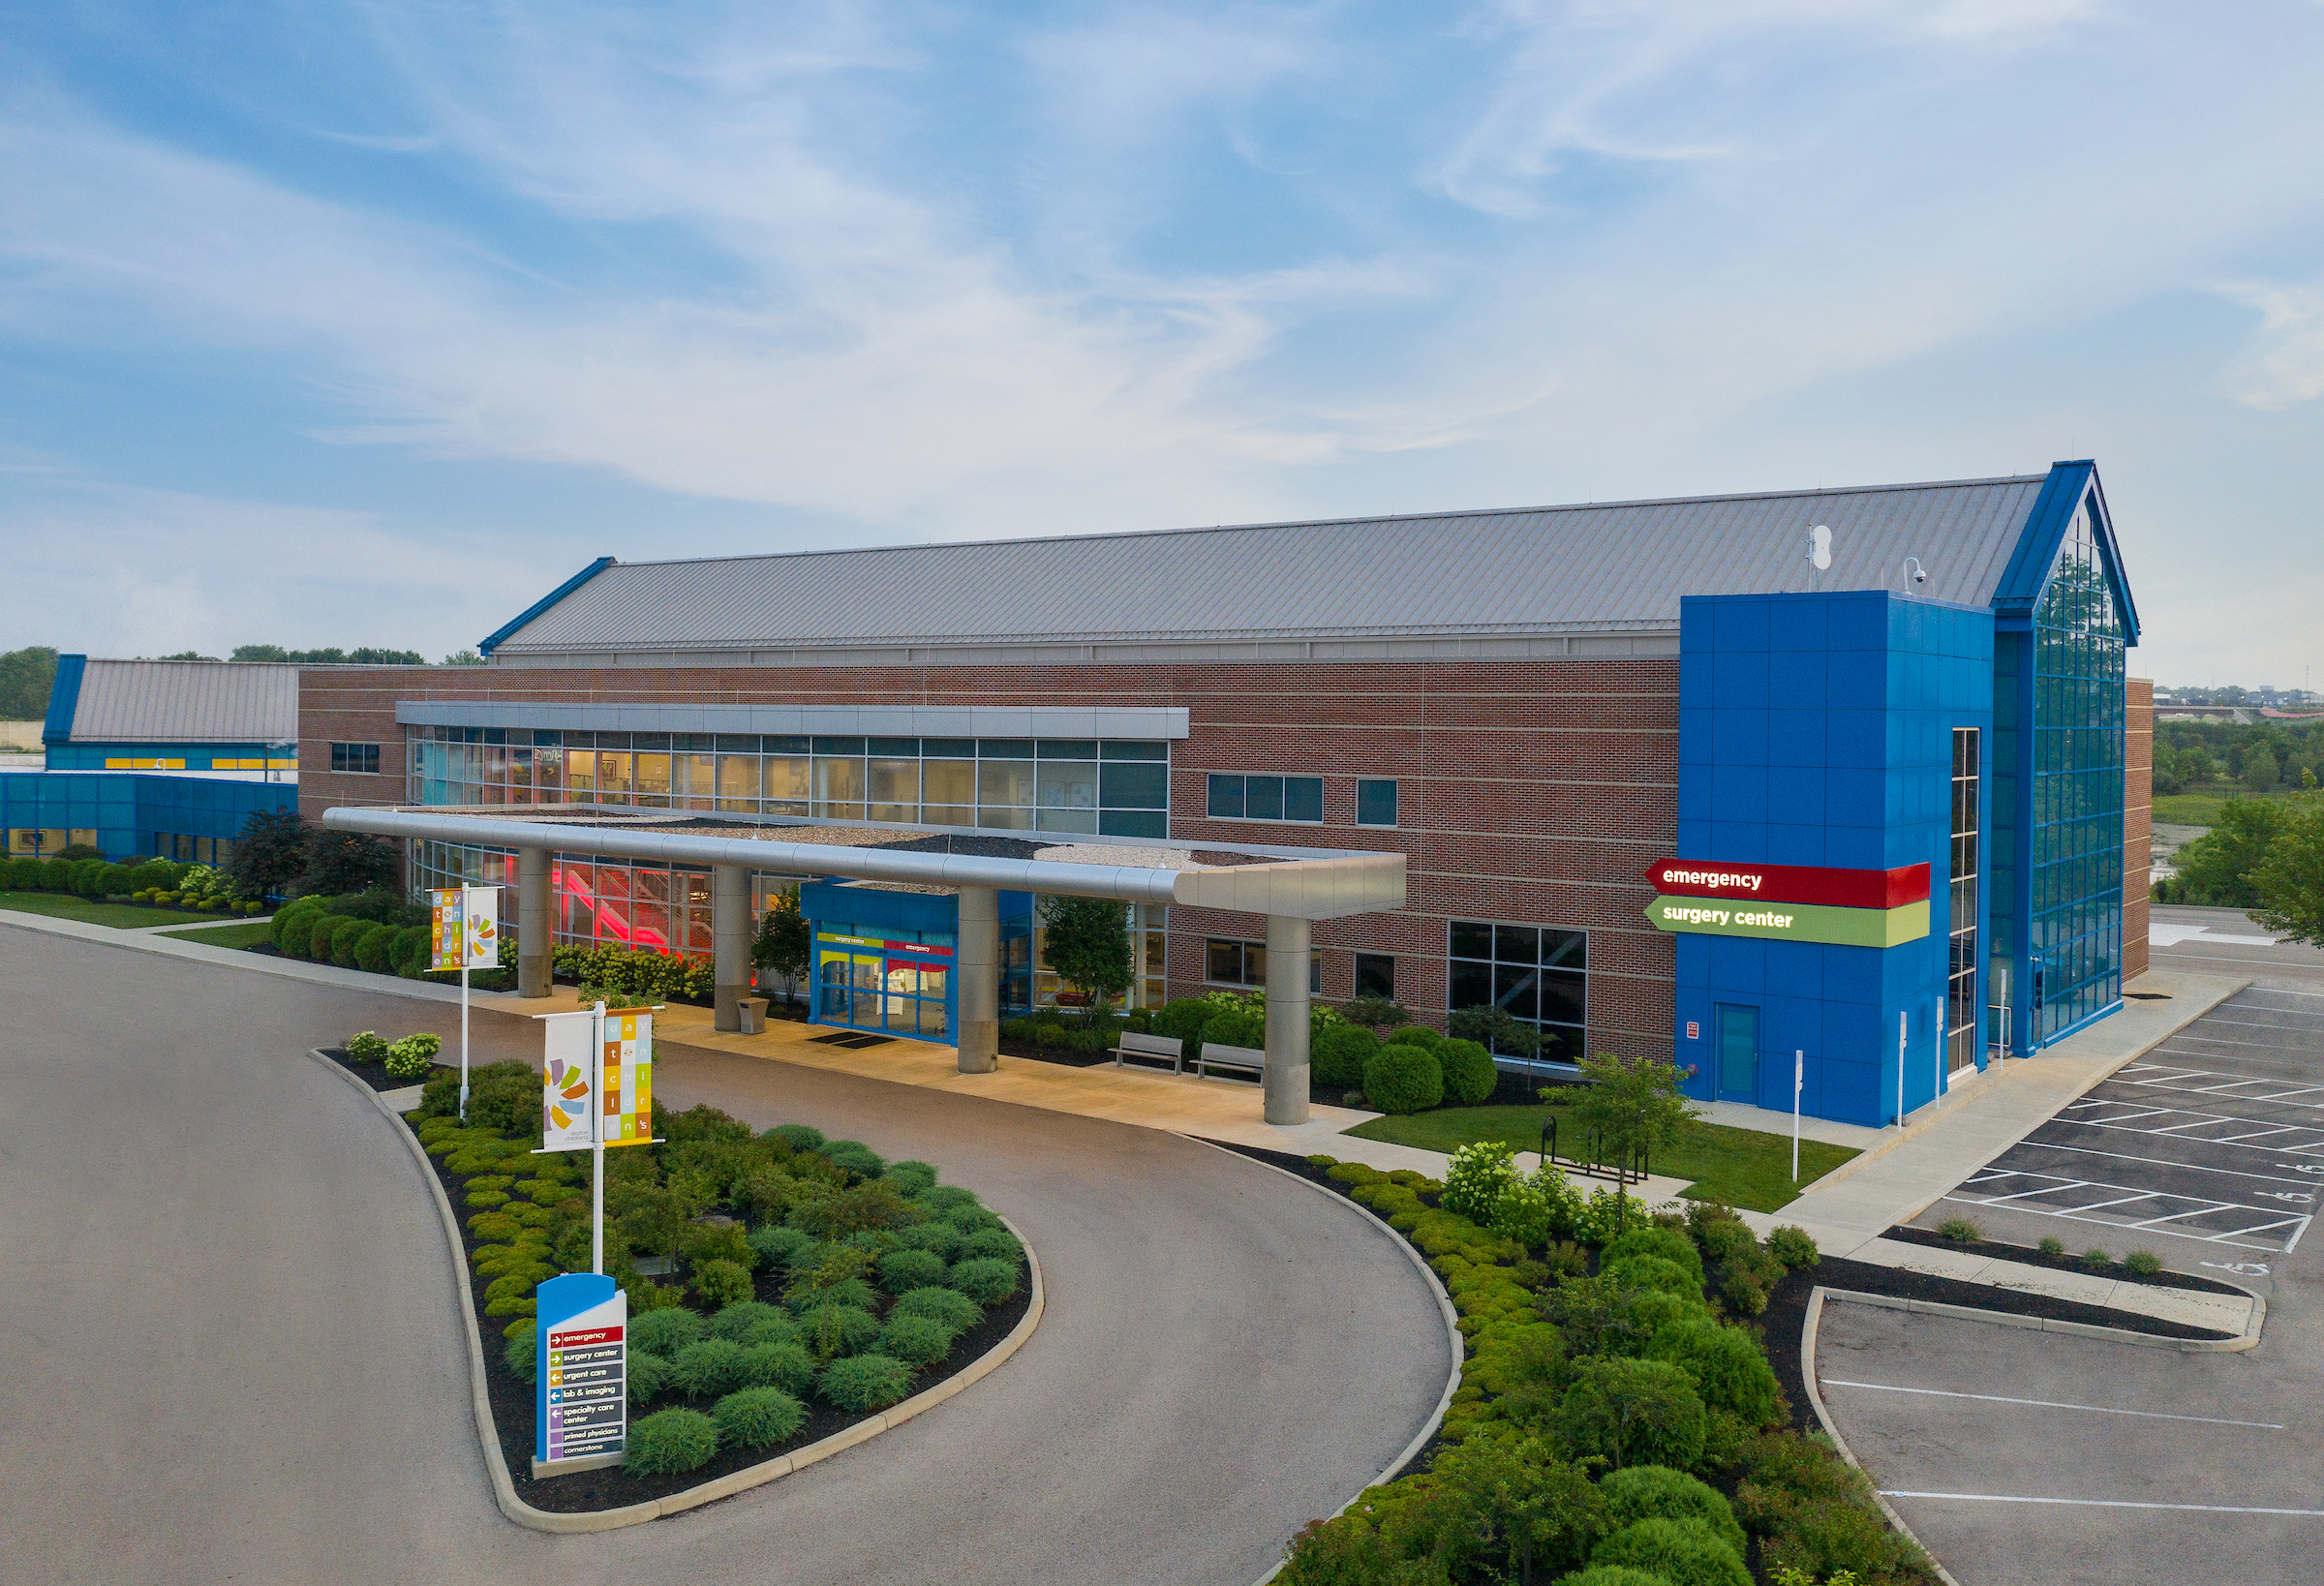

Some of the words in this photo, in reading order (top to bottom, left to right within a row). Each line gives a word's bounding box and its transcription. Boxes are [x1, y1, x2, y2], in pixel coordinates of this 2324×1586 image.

[1663, 869, 1762, 891] emergency
[1663, 906, 1730, 927] surgery
[1734, 910, 1793, 929] center
[905, 944, 931, 953] emergency
[564, 1332, 606, 1342] emergency
[564, 1352, 593, 1361] surgery
[594, 1349, 618, 1357] center
[564, 1370, 589, 1381] urgent
[564, 1389, 575, 1398] lab
[585, 1386, 616, 1395] imaging
[564, 1405, 596, 1417] specialty
[564, 1416, 588, 1424] center
[564, 1430, 587, 1442] primed
[587, 1427, 619, 1438] physicians
[564, 1444, 603, 1454] cornerstone
